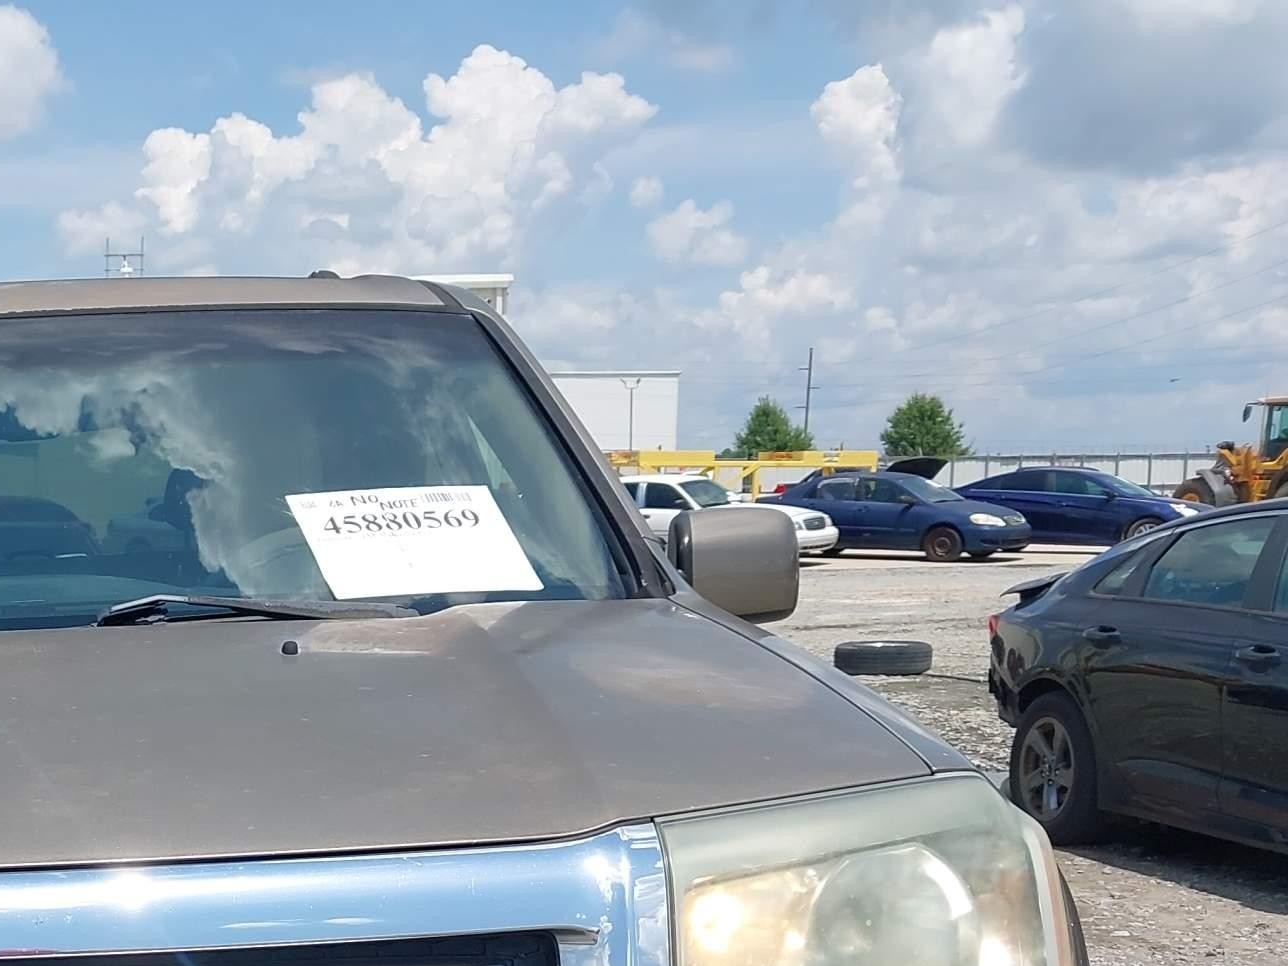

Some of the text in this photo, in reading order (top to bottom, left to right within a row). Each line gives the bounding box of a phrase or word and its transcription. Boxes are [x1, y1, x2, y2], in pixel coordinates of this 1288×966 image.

[350, 494, 379, 506] NO
[379, 498, 419, 511] NOTE
[324, 508, 480, 534] 45880569
